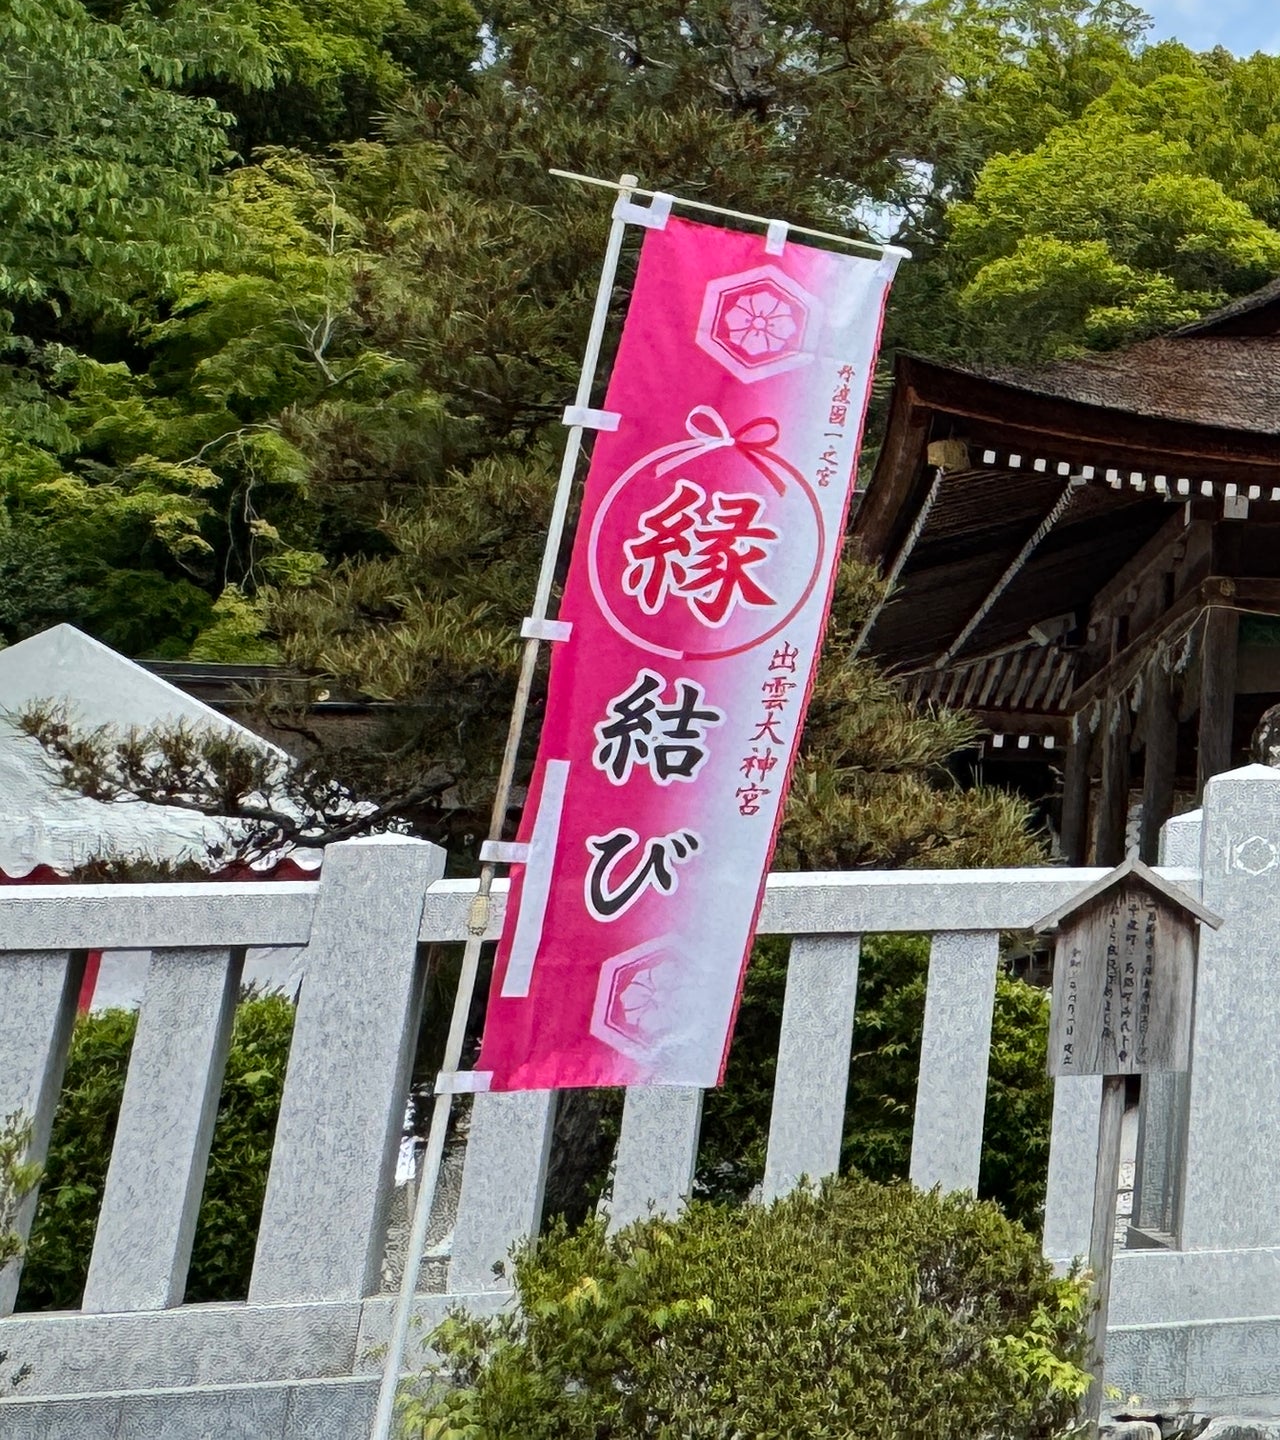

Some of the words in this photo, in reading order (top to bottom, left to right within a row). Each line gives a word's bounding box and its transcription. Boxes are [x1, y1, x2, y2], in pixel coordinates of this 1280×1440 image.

[588, 484, 777, 918] 縁結び
[735, 641, 798, 816] 出雲大神宮
